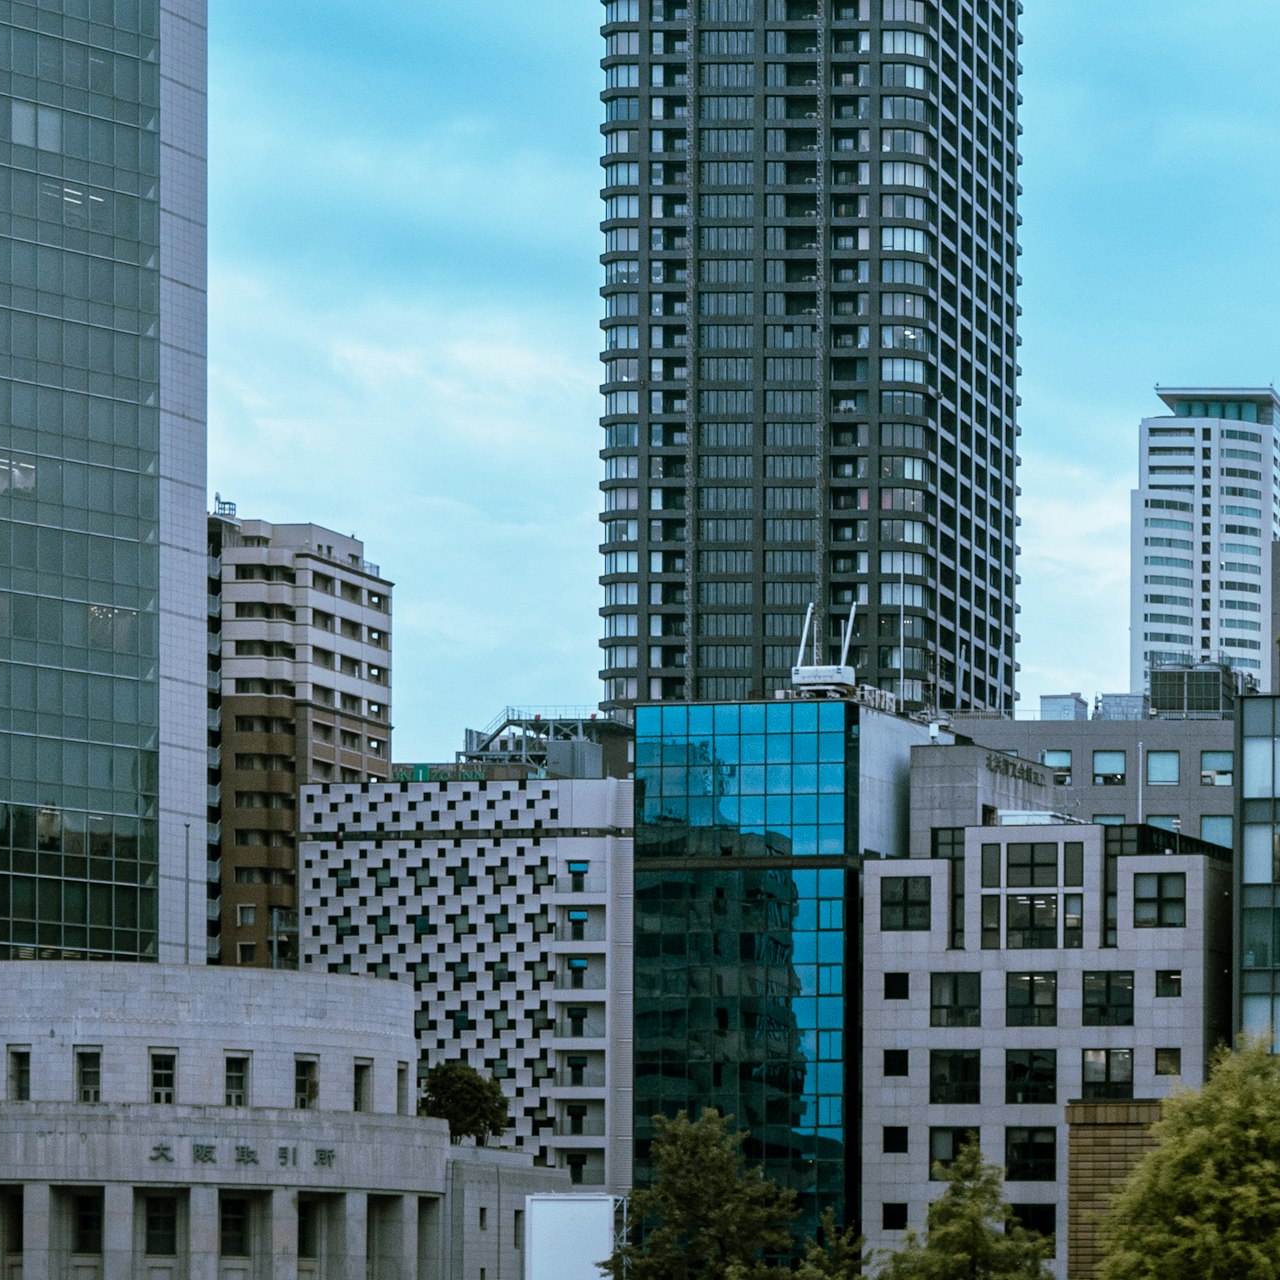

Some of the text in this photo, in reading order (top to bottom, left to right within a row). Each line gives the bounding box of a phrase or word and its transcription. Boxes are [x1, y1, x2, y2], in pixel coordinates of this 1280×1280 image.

[149, 1143, 336, 1167] 大阪取引所
